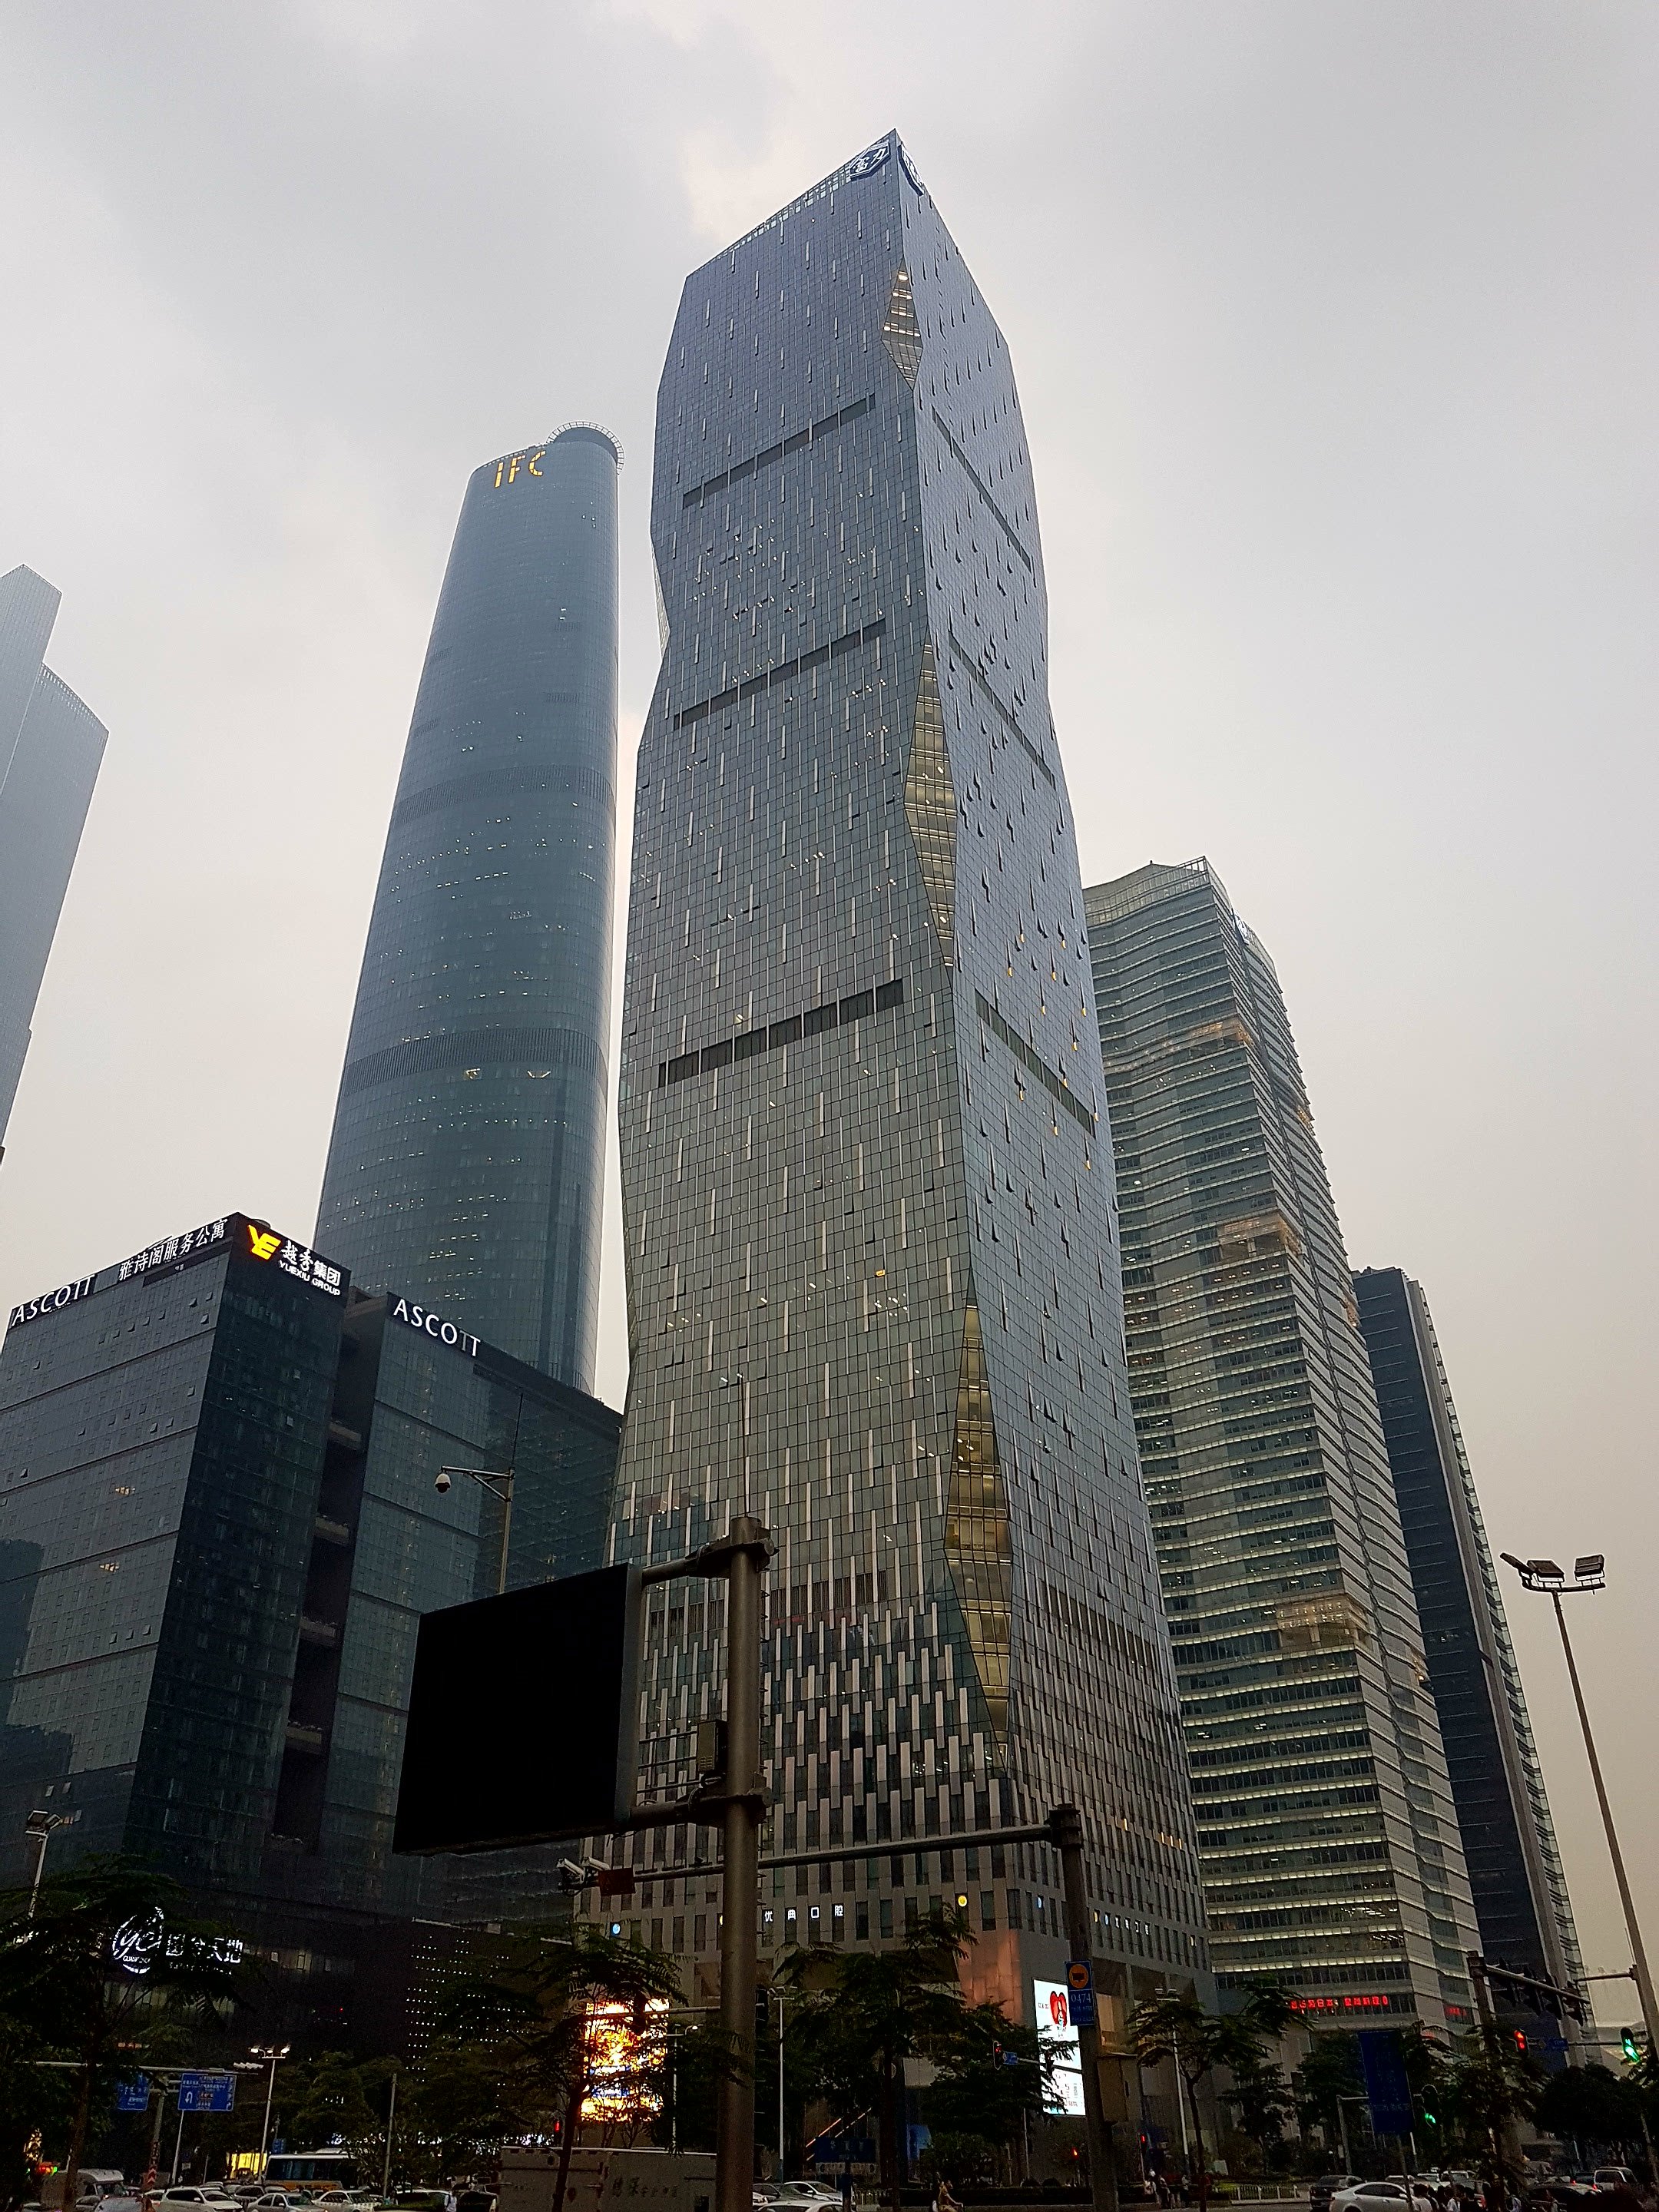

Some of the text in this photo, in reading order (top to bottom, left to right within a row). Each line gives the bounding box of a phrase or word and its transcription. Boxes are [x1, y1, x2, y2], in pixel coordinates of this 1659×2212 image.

[118, 1218, 228, 1281] 雅诗阁服务公寓
[280, 1239, 341, 1286] 越秀集团
[11, 1273, 95, 1326] ASCOTT
[279, 1260, 341, 1296] YUEXIU GROUP
[393, 1298, 481, 1357] ASCOTT
